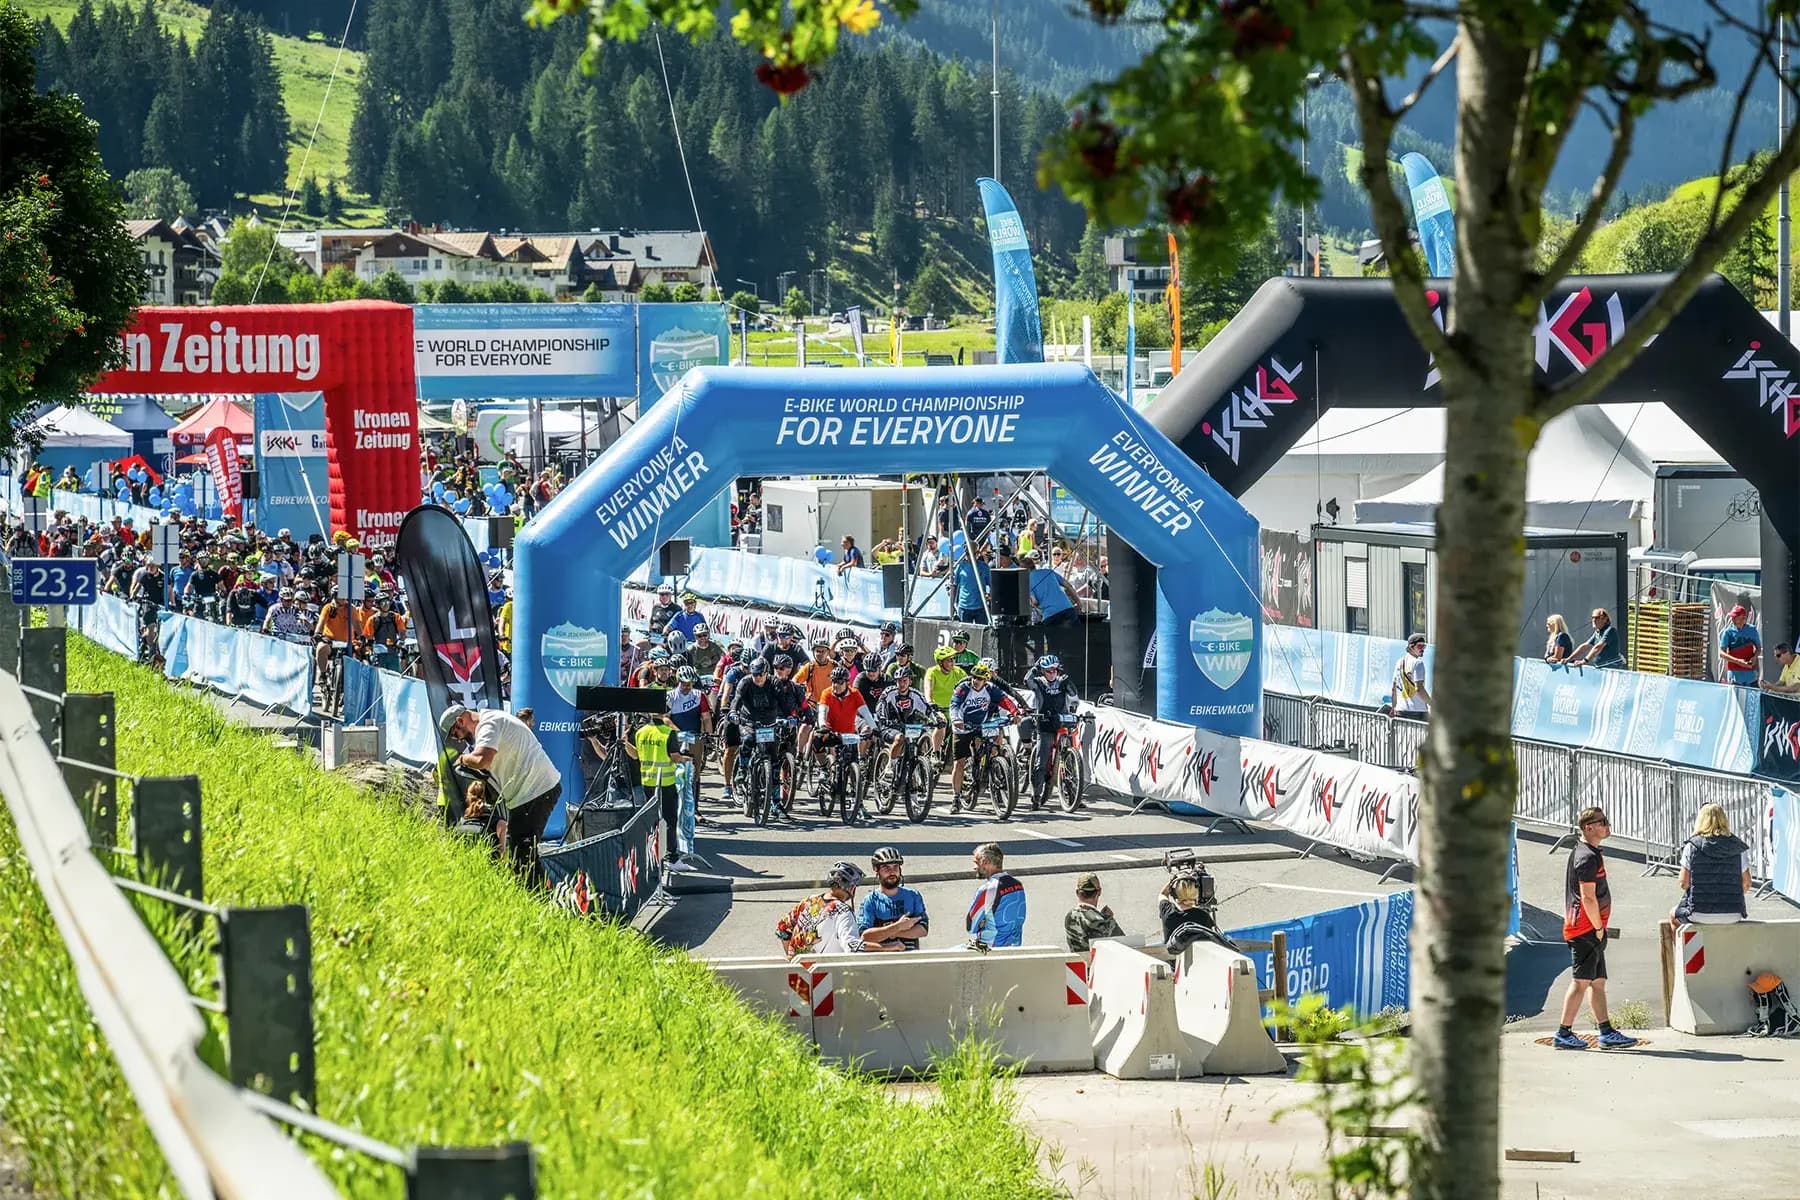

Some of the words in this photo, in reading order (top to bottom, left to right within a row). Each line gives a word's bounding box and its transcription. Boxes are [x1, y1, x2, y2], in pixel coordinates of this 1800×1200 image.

[160, 321, 320, 381] Zeitung
[428, 340, 486, 353] WORLD
[490, 338, 610, 352] CHAMPIONSHIP
[435, 354, 466, 367] FOR
[470, 353, 552, 367] EVERYONE
[89, 405, 123, 414] CARE
[784, 397, 836, 413] E-BIKE
[840, 397, 898, 413] WORLD
[902, 395, 1025, 412] CHAMPIONSHIP
[353, 409, 411, 429] Kronen
[355, 430, 411, 450] Zeitung
[776, 417, 843, 446] FOR
[850, 414, 1021, 446] EVERYONE
[595, 446, 675, 525] EVERYONE
[673, 435, 689, 455] A
[1112, 430, 1194, 502] EVERYONE
[1187, 498, 1205, 513] A
[1088, 443, 1192, 537] WINNER
[270, 496, 330, 505] EBIKEWM.CO
[608, 451, 710, 550] WINNER
[358, 529, 398, 549] Zeitu
[13, 568, 23, 585] 188
[31, 568, 89, 600] 23,2
[13, 588, 23, 596] B
[1204, 655, 1241, 672] WM
[555, 671, 594, 687] WM
[683, 697, 697, 711] FOX
[1190, 703, 1254, 716] EBIKEWM.COM
[1553, 694, 1580, 714] WORLD
[538, 721, 581, 732] EBIKEW
[1674, 712, 1704, 733] WORLD
[1266, 946, 1313, 974] EBIKE
